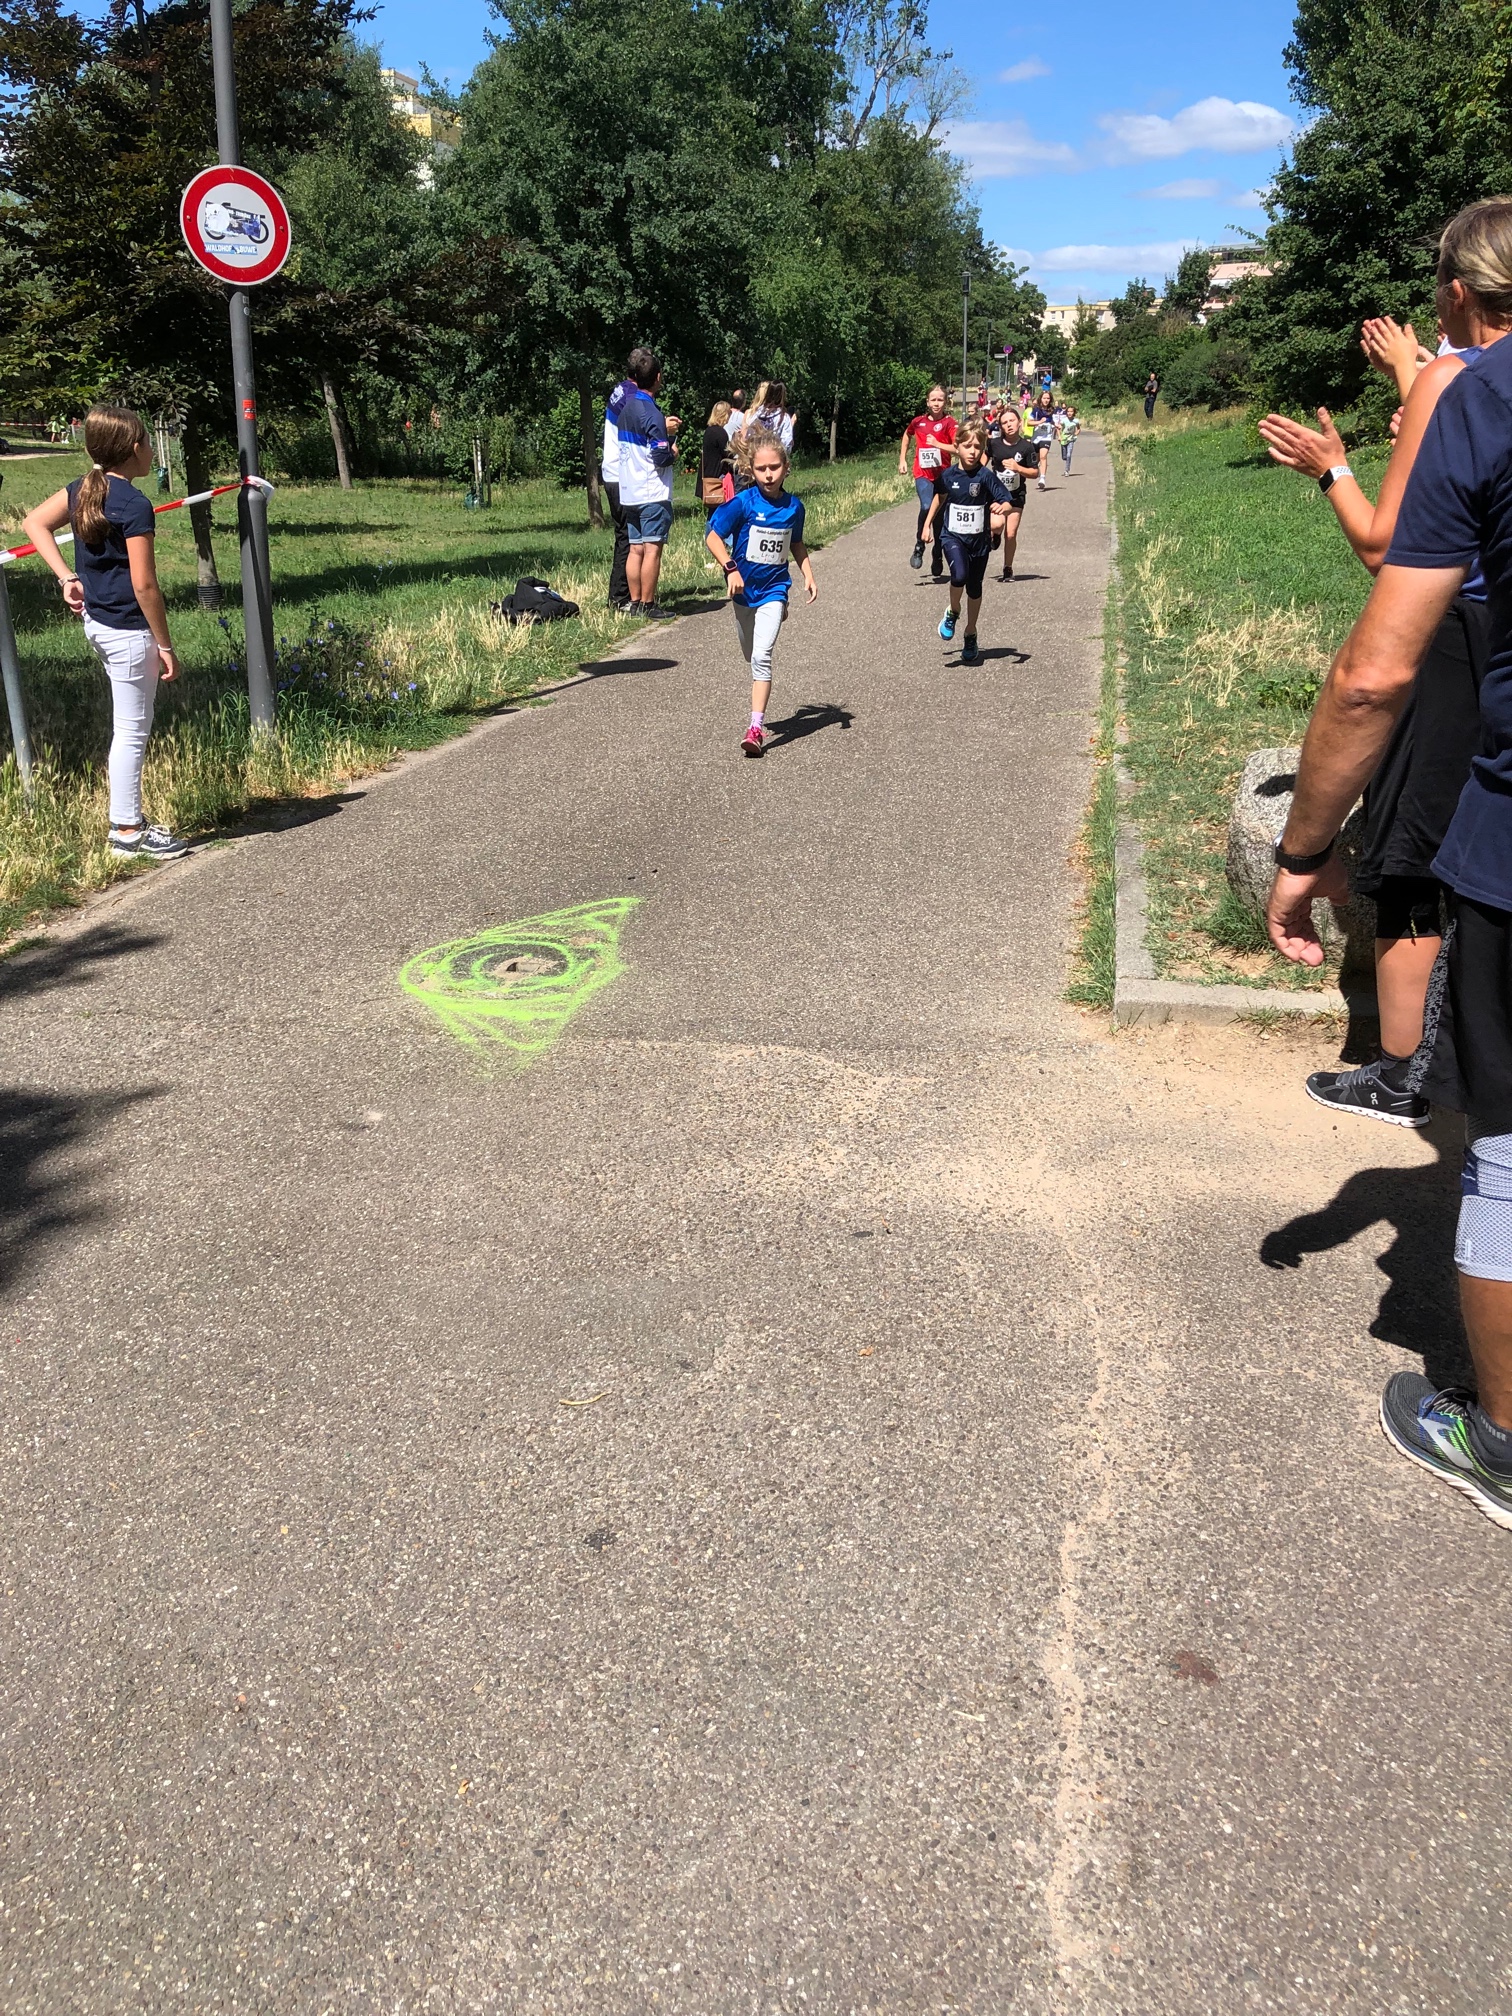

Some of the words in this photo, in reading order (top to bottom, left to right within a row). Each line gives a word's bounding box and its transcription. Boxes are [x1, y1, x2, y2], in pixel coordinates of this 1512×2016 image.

[921, 452, 935, 460] 557
[1001, 477, 1015, 485] 552
[956, 511, 975, 522] 581
[759, 539, 783, 553] 635
